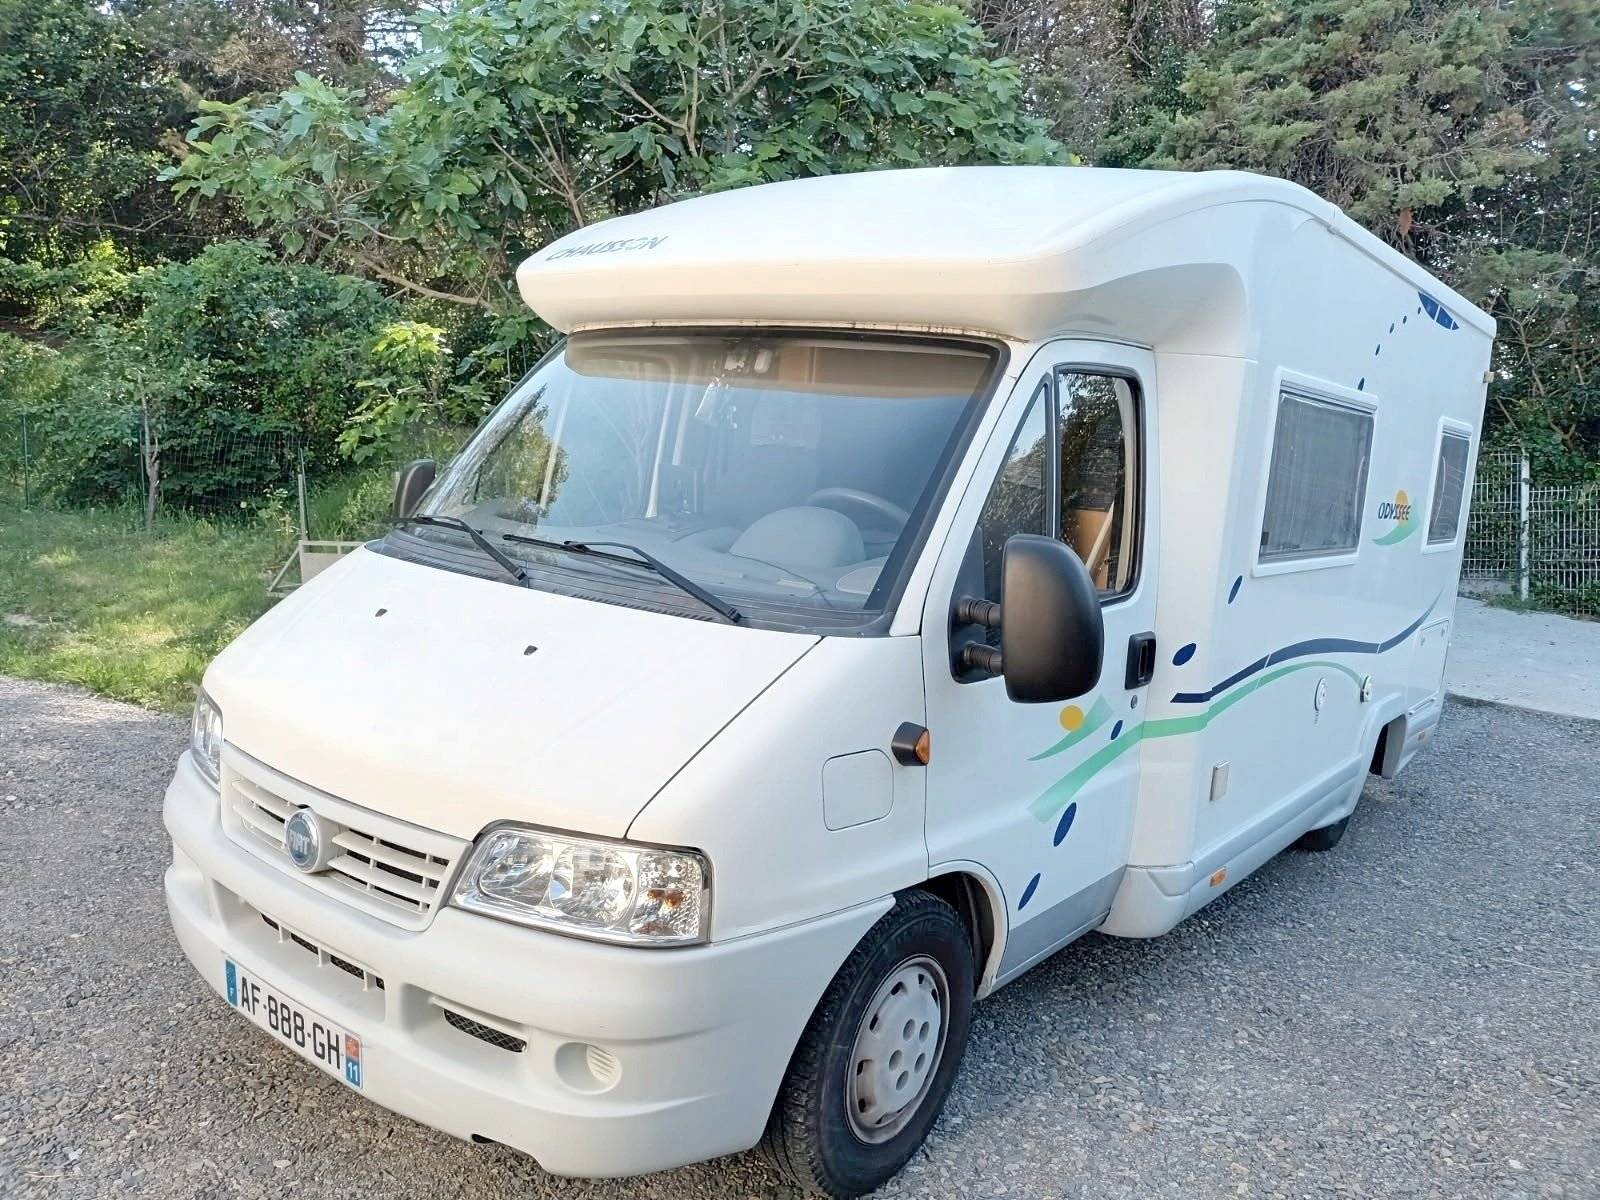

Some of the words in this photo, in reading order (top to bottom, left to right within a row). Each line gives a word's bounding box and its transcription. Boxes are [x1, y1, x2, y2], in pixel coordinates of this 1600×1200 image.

[545, 235, 669, 262] CHAUSSON
[1377, 502, 1411, 521] ODYSSEE
[289, 829, 311, 856] FIAT
[347, 1061, 359, 1082] 11
